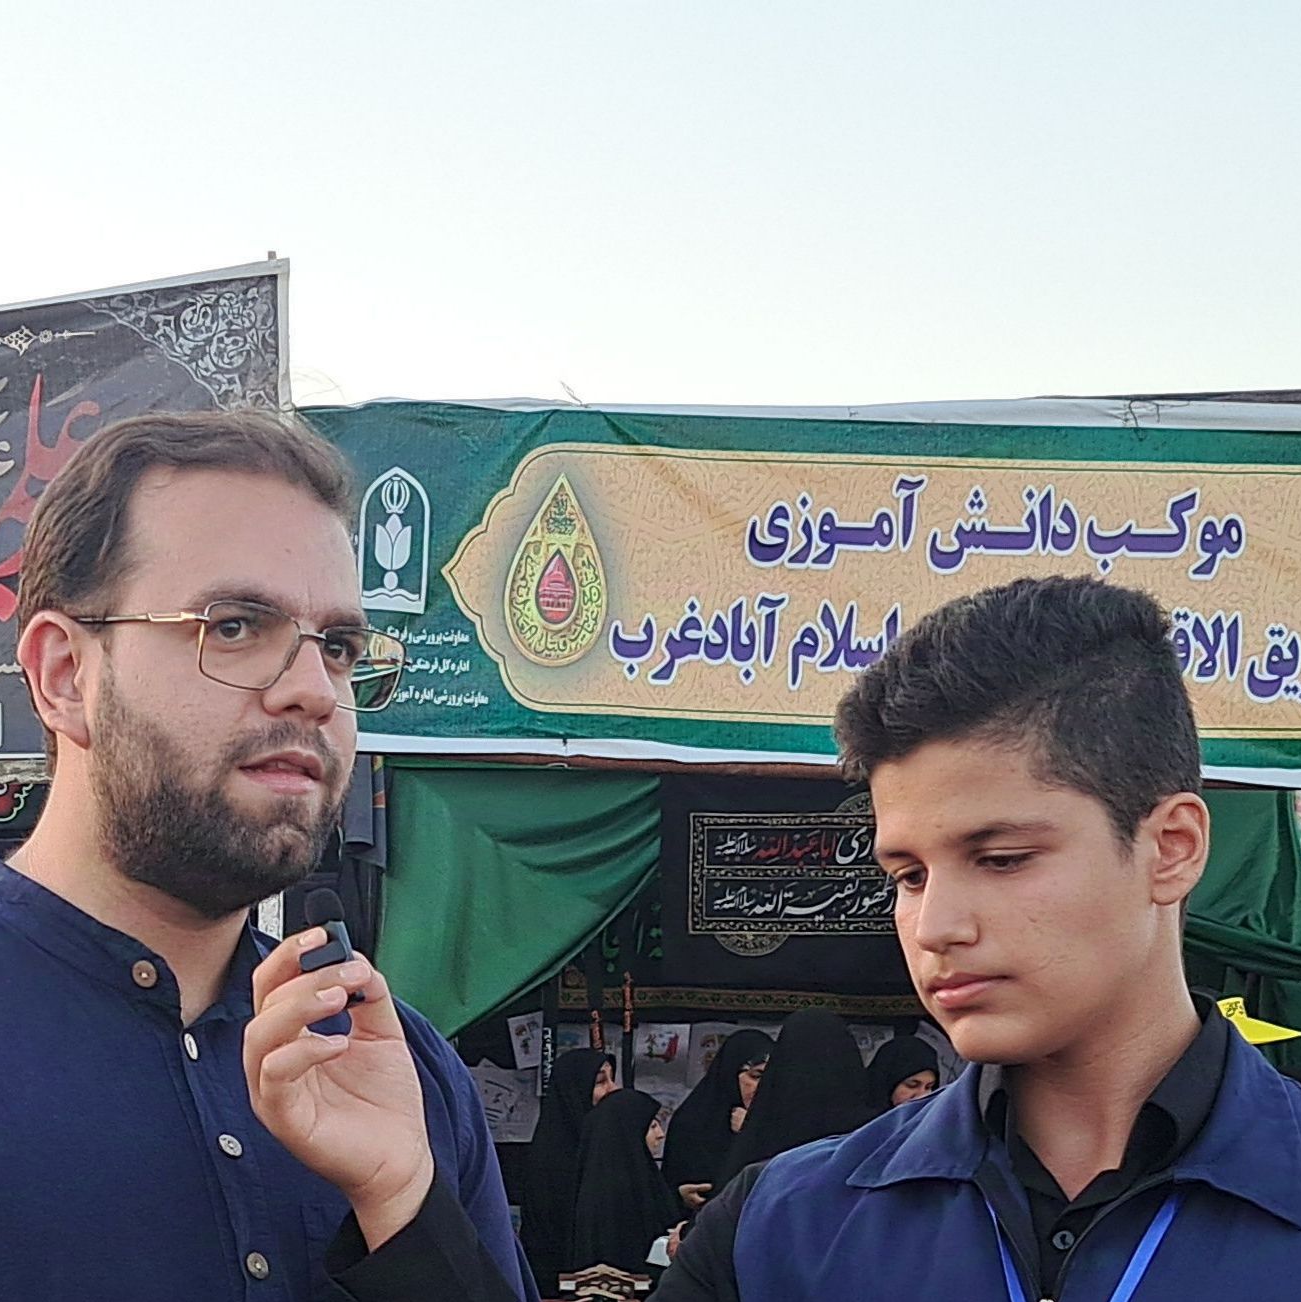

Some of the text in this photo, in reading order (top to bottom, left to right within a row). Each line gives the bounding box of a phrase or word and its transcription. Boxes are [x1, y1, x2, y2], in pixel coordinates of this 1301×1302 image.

[747, 475, 1244, 579] موکب دانش آموزی
